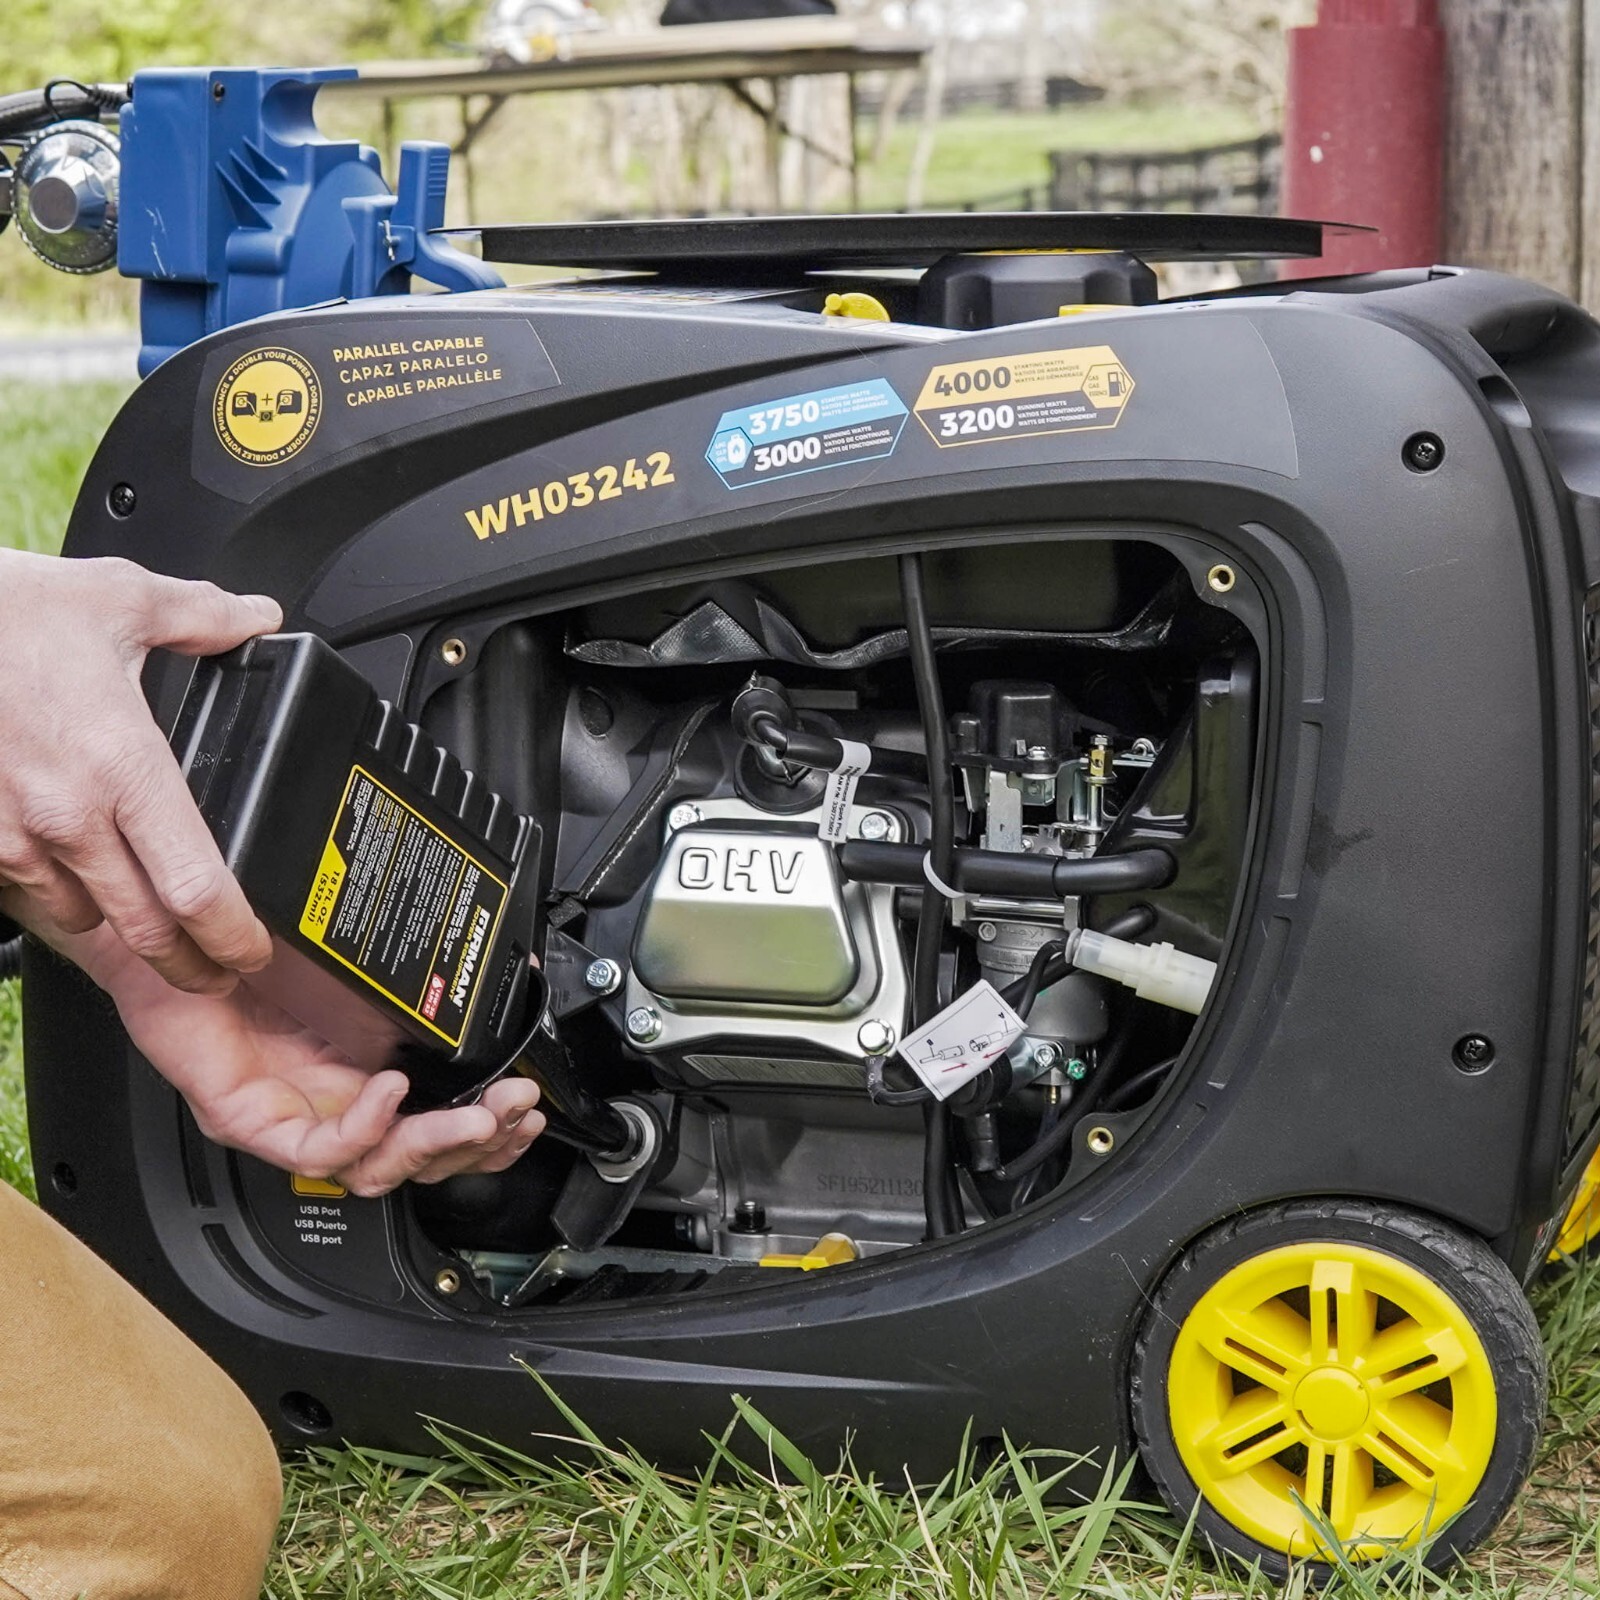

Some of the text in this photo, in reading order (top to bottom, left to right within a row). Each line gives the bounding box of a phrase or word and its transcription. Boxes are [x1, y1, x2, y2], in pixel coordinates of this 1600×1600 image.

[232, 351, 311, 379] DOUBLE YOUR POWER
[333, 336, 484, 362] PARALLEL CAPABLE
[340, 353, 488, 384] CAPAZ PARALELO
[934, 366, 1011, 398] 4000
[347, 368, 502, 407] CAPABLE PARALLÈLE
[286, 385, 318, 453] DOBLE SU PODER
[748, 400, 820, 435] 3750
[940, 404, 1014, 438] 3200
[1017, 400, 1068, 410] RUNNING WATTS
[1018, 411, 1040, 419] VATIOS
[1050, 406, 1086, 416] CONTINUOS
[217, 382, 278, 462] DOUBLEZ VOTRE PUISSANCE
[823, 426, 872, 440] RUNNING WATTS
[754, 436, 821, 472] 3000
[824, 430, 890, 448] VATIOS DE CONTINUOS
[464, 452, 675, 540] WH03242
[329, 868, 340, 886] 18
[678, 845, 806, 894] OHV
[306, 871, 329, 924] (532ml)
[447, 903, 481, 1001] POWER EQUIPMENT
[452, 906, 490, 1009] FIRMAN
[295, 1219, 347, 1231] USB Puerto
[300, 1206, 341, 1217] USB Port
[301, 1234, 342, 1246] USB port
